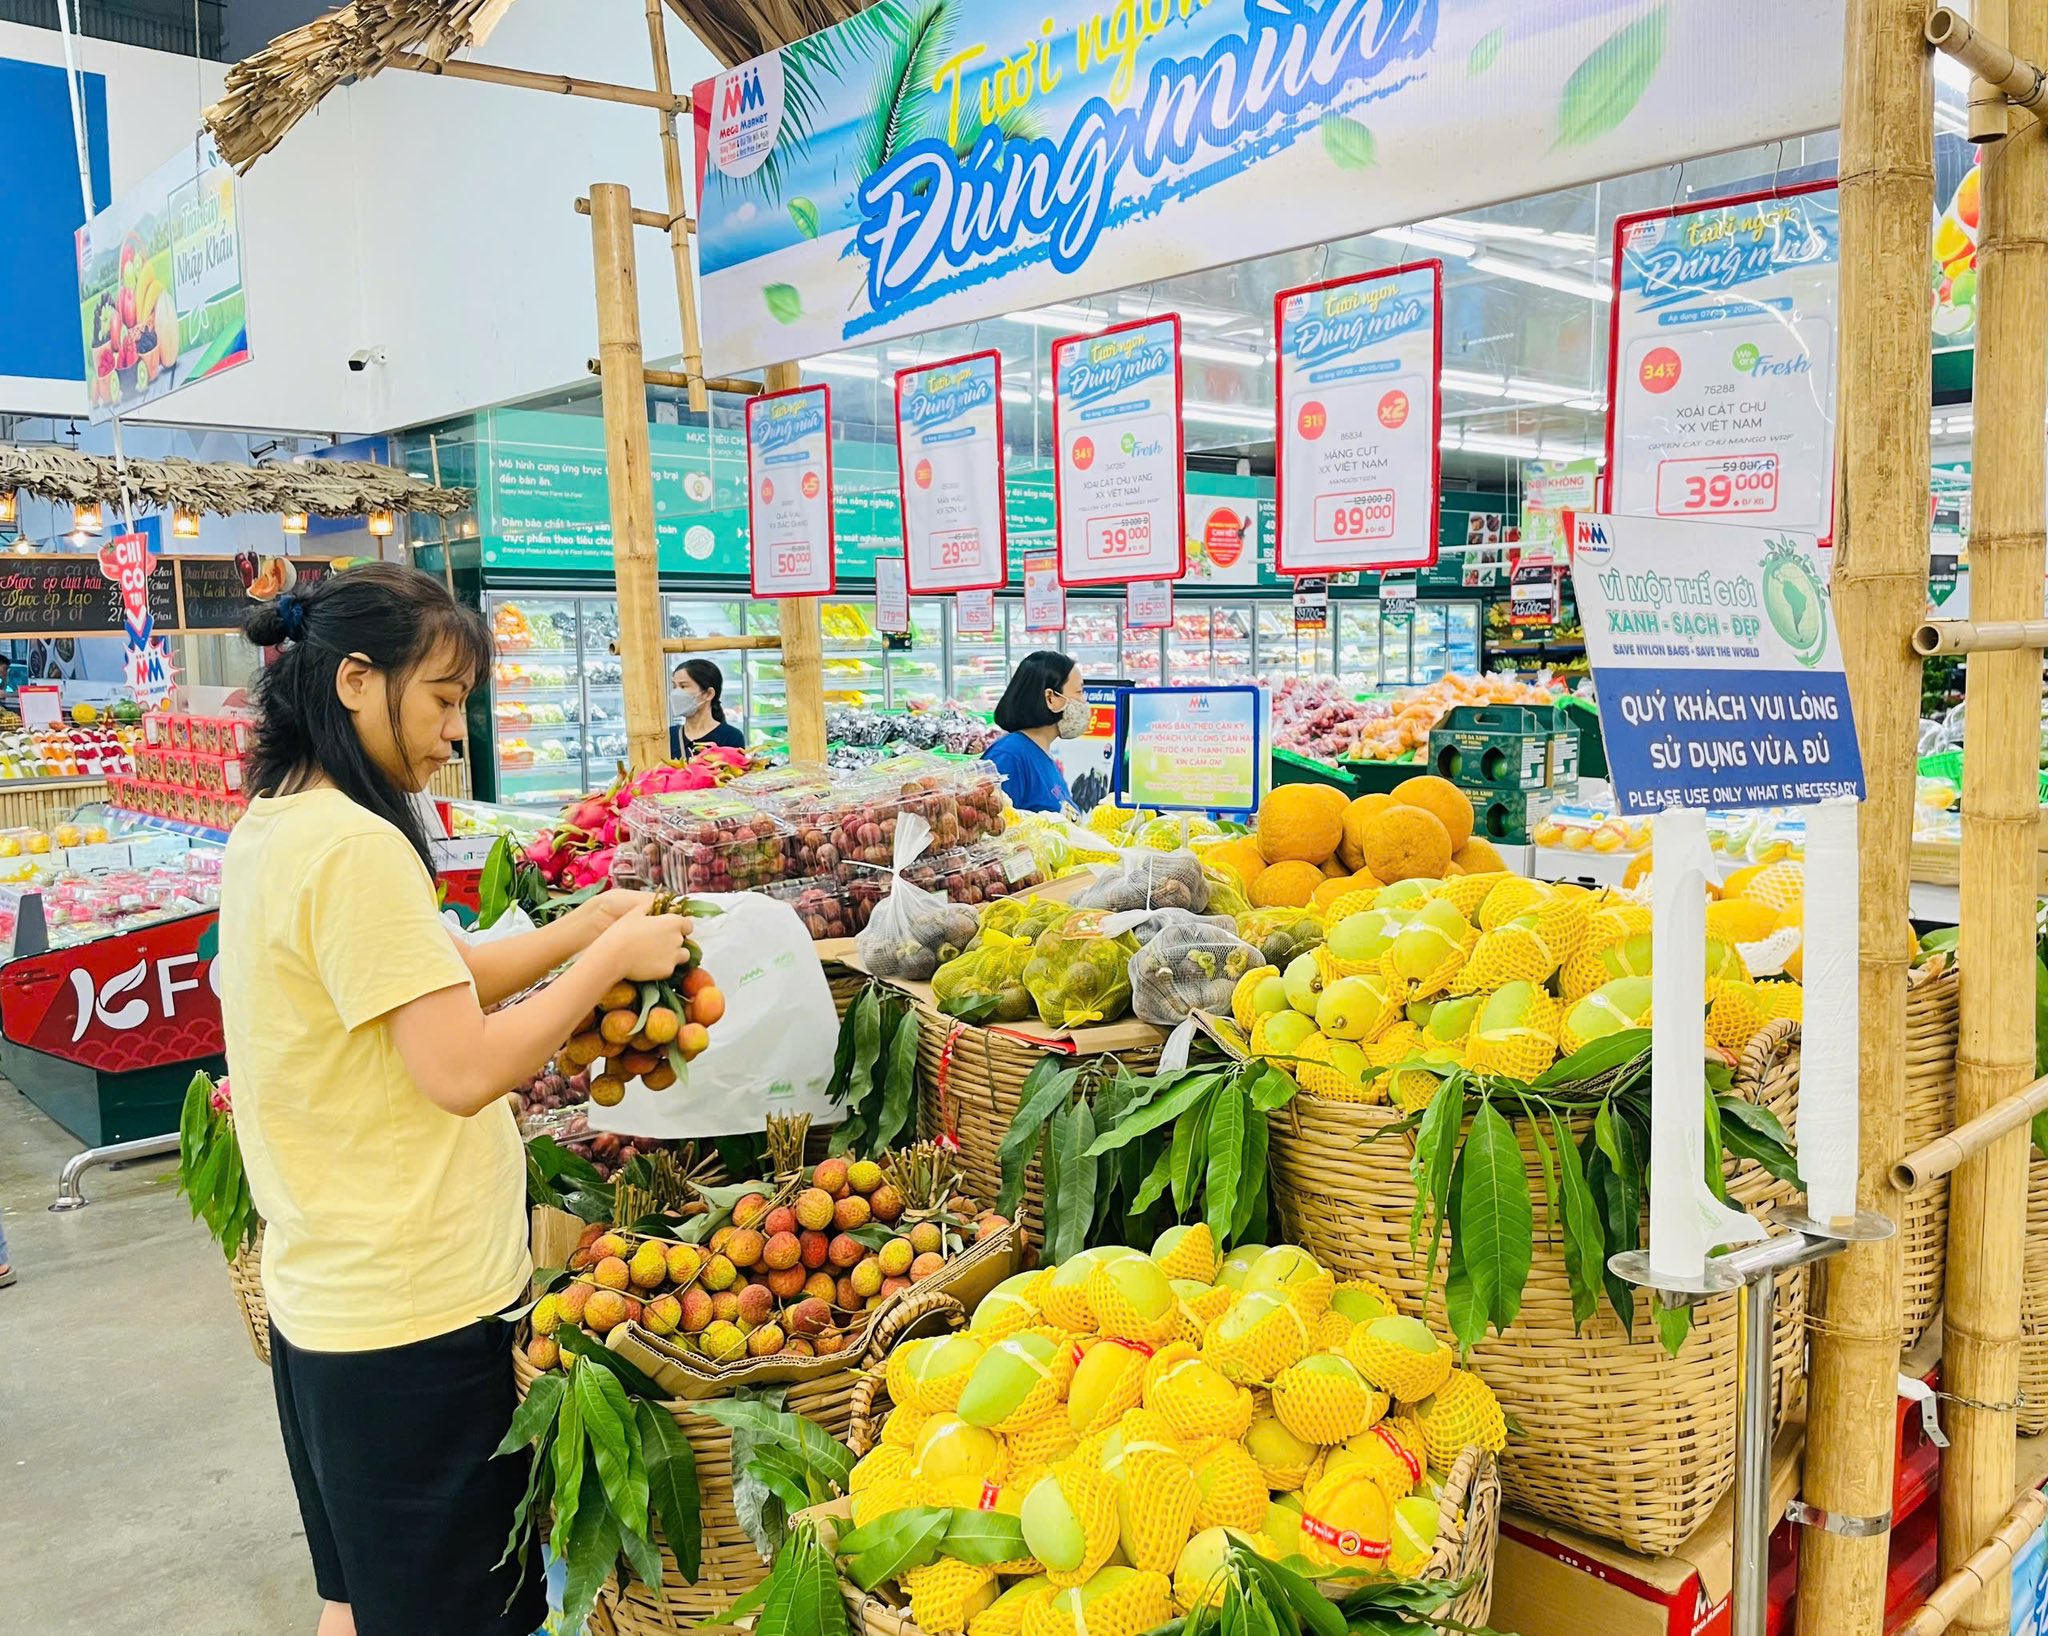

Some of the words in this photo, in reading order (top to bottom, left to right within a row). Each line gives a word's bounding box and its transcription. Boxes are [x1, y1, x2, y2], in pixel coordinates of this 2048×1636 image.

[932, 17, 1062, 148] Tươi
[866, 112, 1128, 301] Đúng
[1145, 0, 1405, 161] mùa
[1645, 246, 1746, 294] Đúng
[1295, 319, 1365, 356] Đúng
[1366, 301, 1421, 336] mùa
[1070, 362, 1124, 396] Đúng
[1125, 348, 1166, 379] mùa
[1751, 354, 1812, 378] Fresh
[1704, 383, 1735, 396] 76288
[912, 395, 957, 422] Đúng
[1732, 417, 1762, 431] NAM
[1682, 440, 1704, 448] CAT
[1729, 435, 1767, 444] MANGO
[1362, 458, 1388, 469] NAM
[1599, 566, 1622, 601] VÌ
[1627, 569, 1672, 609] MỘT
[1675, 570, 1711, 606] THẾ
[1714, 575, 1758, 608] GIỚI
[1608, 609, 1660, 635] XANH
[1674, 611, 1719, 642] SẠCH
[1731, 615, 1761, 643] ĐẸP
[1613, 643, 1635, 656] SAVE
[1636, 644, 1665, 657] NYLON
[1667, 645, 1690, 657] BAGS
[1695, 645, 1716, 658] SAVE
[1717, 646, 1732, 658] THE
[1732, 646, 1760, 658] WORLD
[1621, 689, 1666, 727] QUÝ
[1674, 688, 1747, 721] KHÁCH
[1751, 694, 1789, 721] VUI
[1790, 689, 1839, 721] LÒNG
[1650, 735, 1681, 769] SỬ
[1689, 740, 1746, 774] DỤNG
[1750, 734, 1799, 766] VỪA
[1803, 732, 1831, 764] ĐỦ
[1629, 789, 1682, 808] PLEASE
[1685, 787, 1711, 805] USE
[1713, 785, 1744, 804] ONLY
[1747, 784, 1780, 802] WHAT
[1782, 784, 1794, 800] IS
[1796, 781, 1858, 799] NECESSARY
